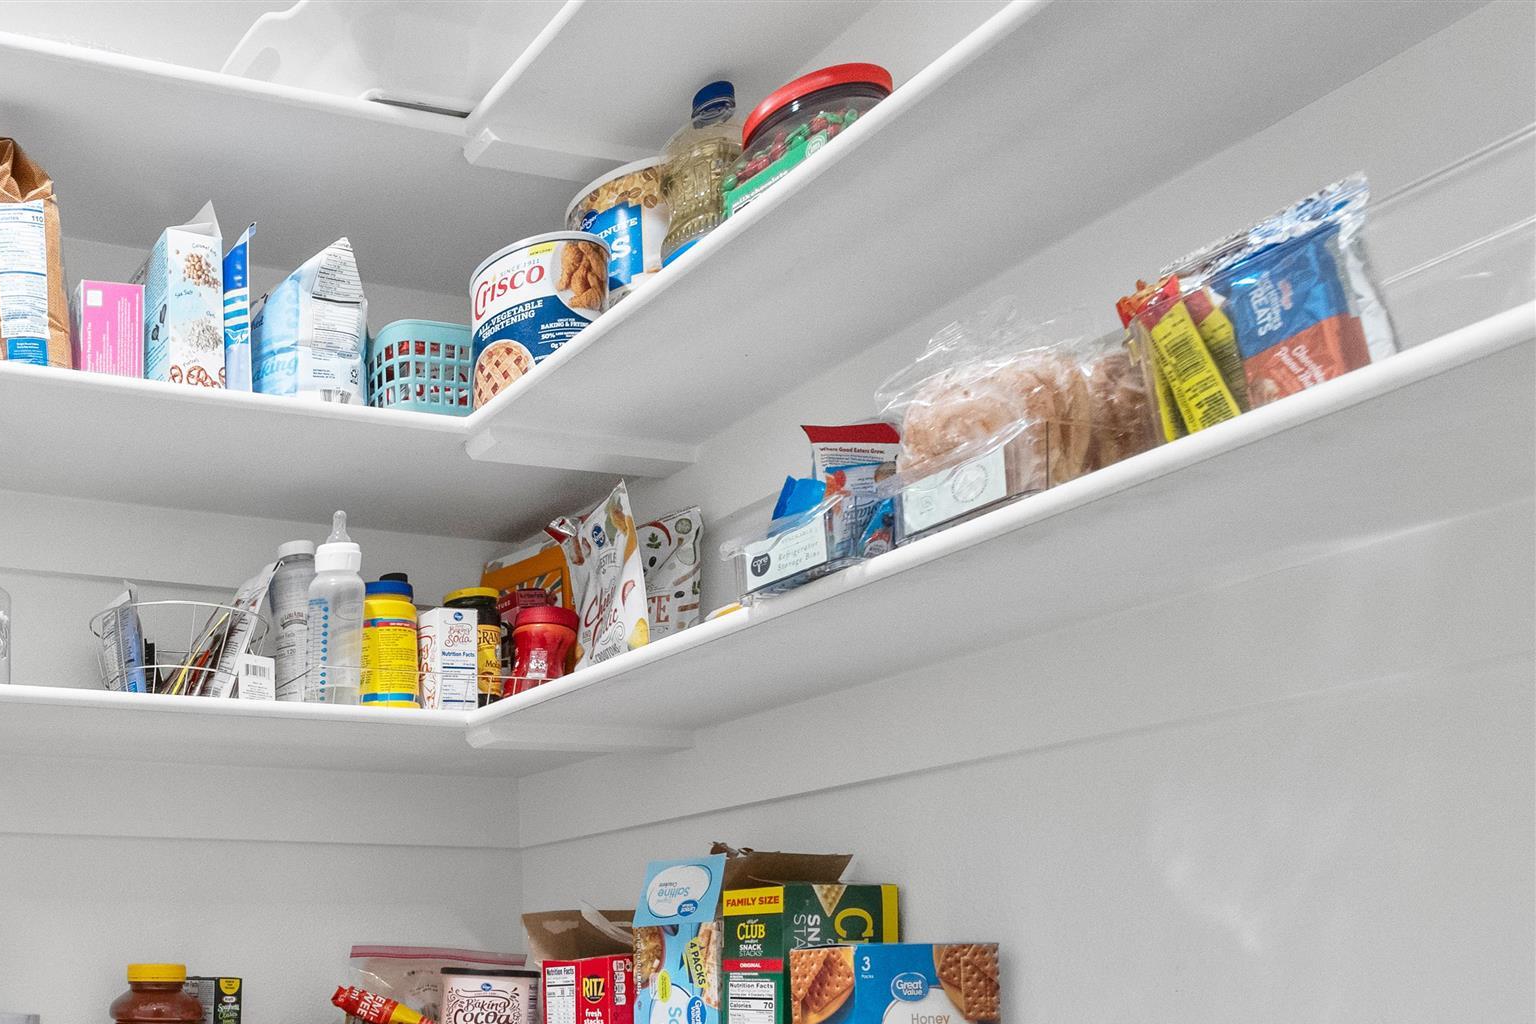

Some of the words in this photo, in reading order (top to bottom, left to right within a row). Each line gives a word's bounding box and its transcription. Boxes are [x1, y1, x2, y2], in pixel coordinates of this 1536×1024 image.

[597, 217, 638, 239] INUTE
[475, 265, 545, 320] Crisco
[478, 300, 543, 337] ALL-VEGETABLE
[482, 310, 535, 341] SHORTENING
[541, 322, 564, 330] BAKING
[541, 332, 556, 340] 50%
[445, 634, 472, 647] Soda
[657, 887, 690, 897] Saltine
[726, 897, 757, 908] FAMILY
[758, 895, 780, 905] SIZE
[737, 922, 766, 940] CLUB
[793, 914, 807, 948] STA
[691, 951, 706, 985] PACKS
[861, 956, 871, 971] 3
[582, 977, 605, 998] RITZ
[896, 979, 923, 990] Great
[902, 988, 923, 996] Value
[369, 995, 385, 1020] EMI-
[464, 998, 509, 1013] Baking
[585, 1008, 602, 1017] fresh
